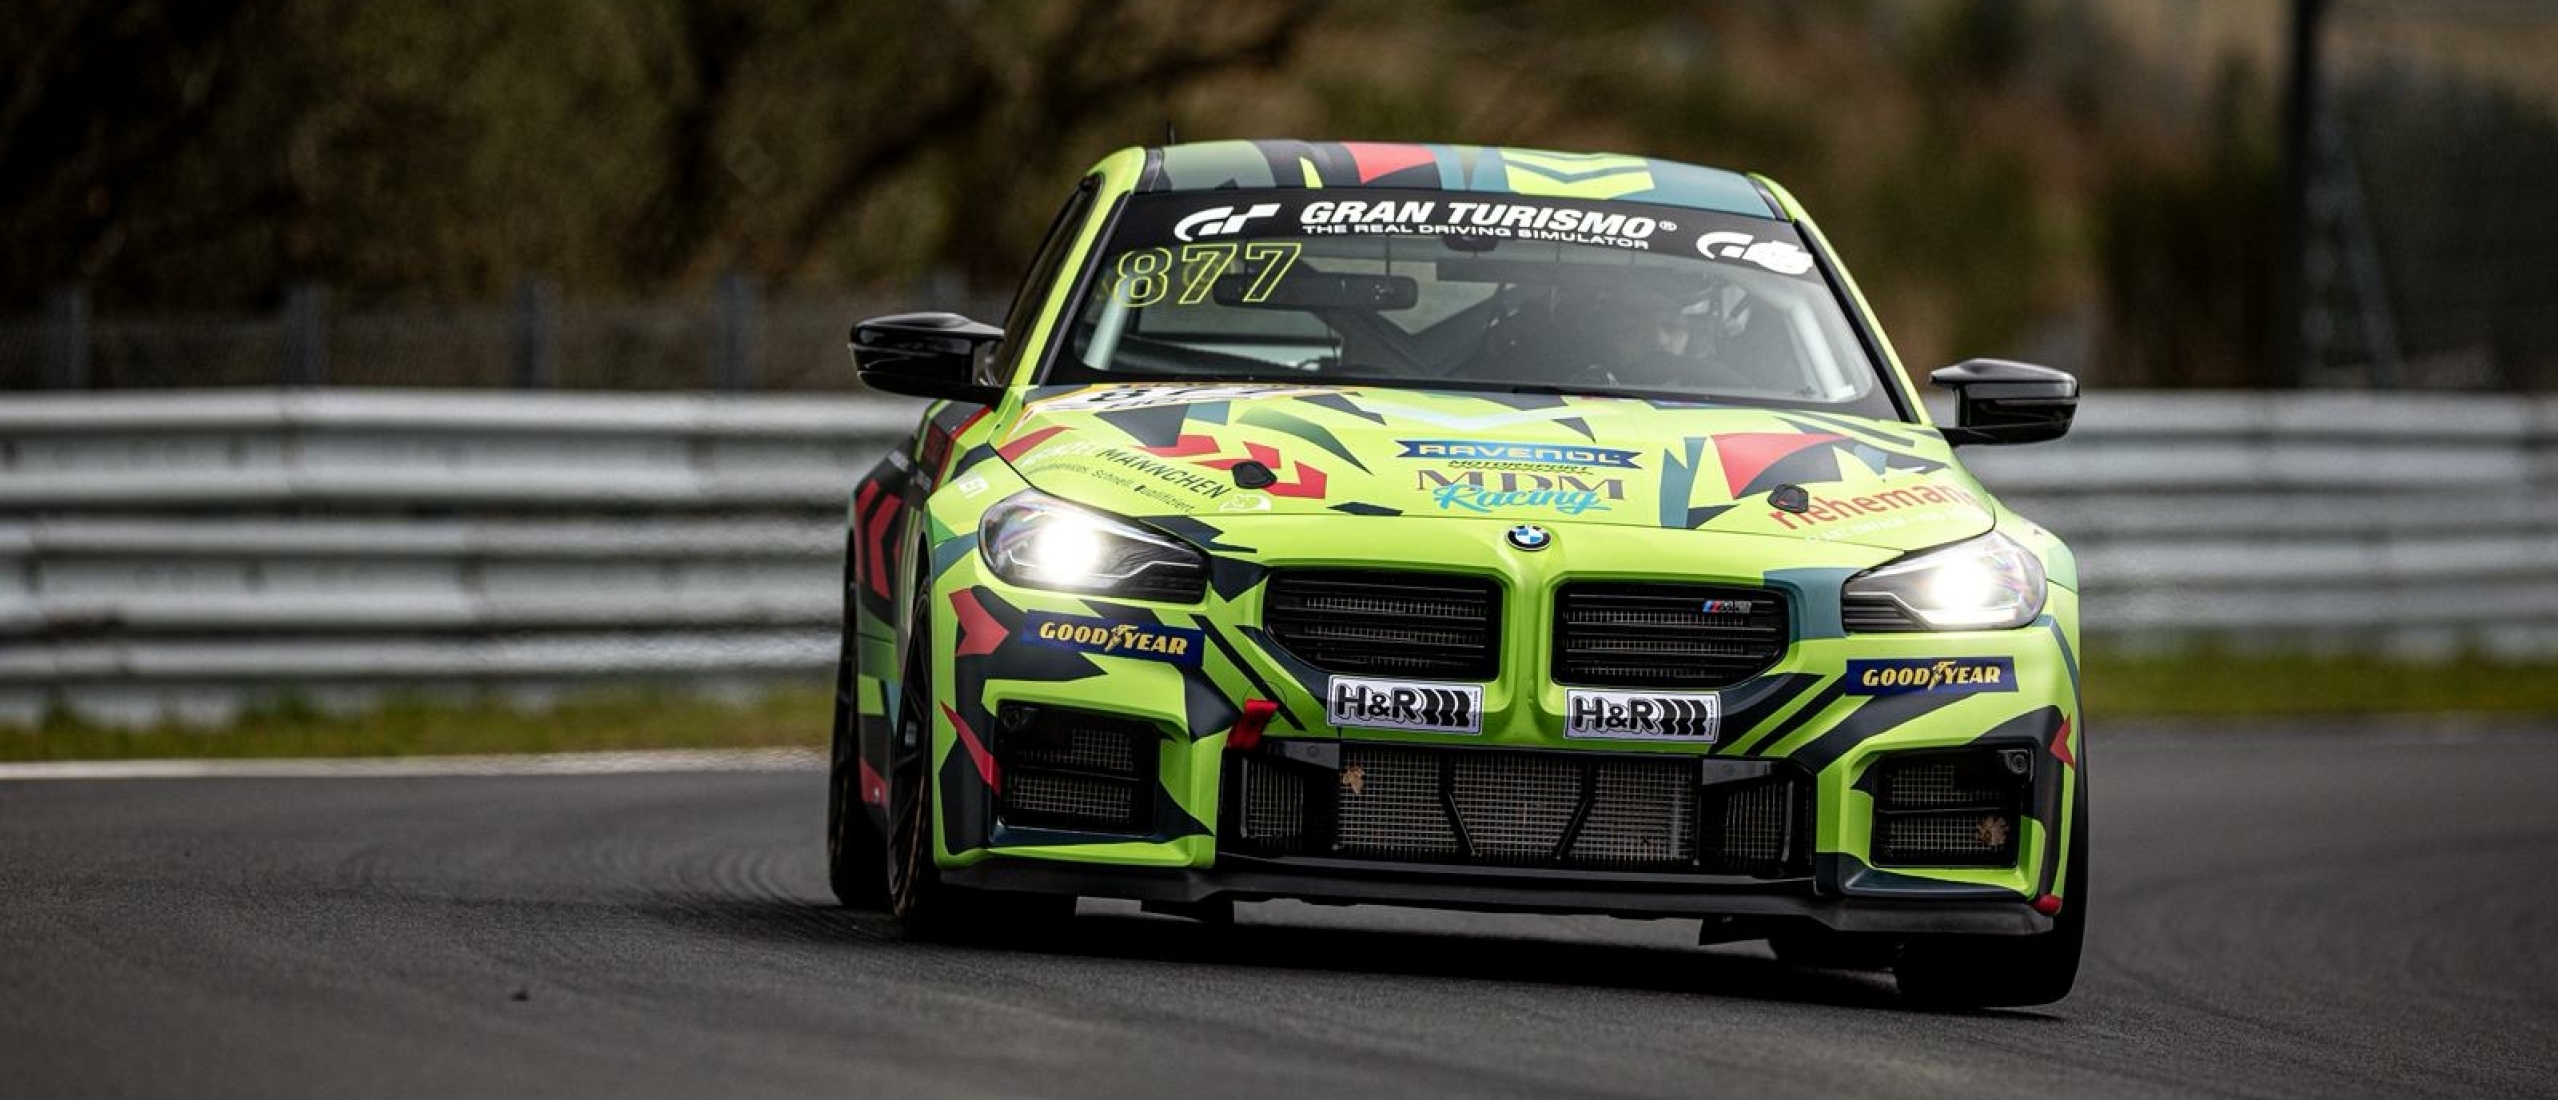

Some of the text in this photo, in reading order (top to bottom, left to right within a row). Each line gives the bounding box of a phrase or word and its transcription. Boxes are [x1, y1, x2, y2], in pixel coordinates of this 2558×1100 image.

[1299, 200, 1435, 225] GRAN
[1302, 224, 1649, 250] THE REAL DRIVING SIMULATOR
[1112, 242, 1303, 308] 877
[1418, 443, 1621, 466] RAVENOL
[1416, 469, 1625, 501] MDM
[1432, 482, 1613, 516] Racing
[1038, 621, 1189, 656] GOODYEAR
[1861, 660, 2002, 692] GOODYEAR
[1335, 683, 1425, 725] H&R
[1570, 697, 1658, 735] H&R
